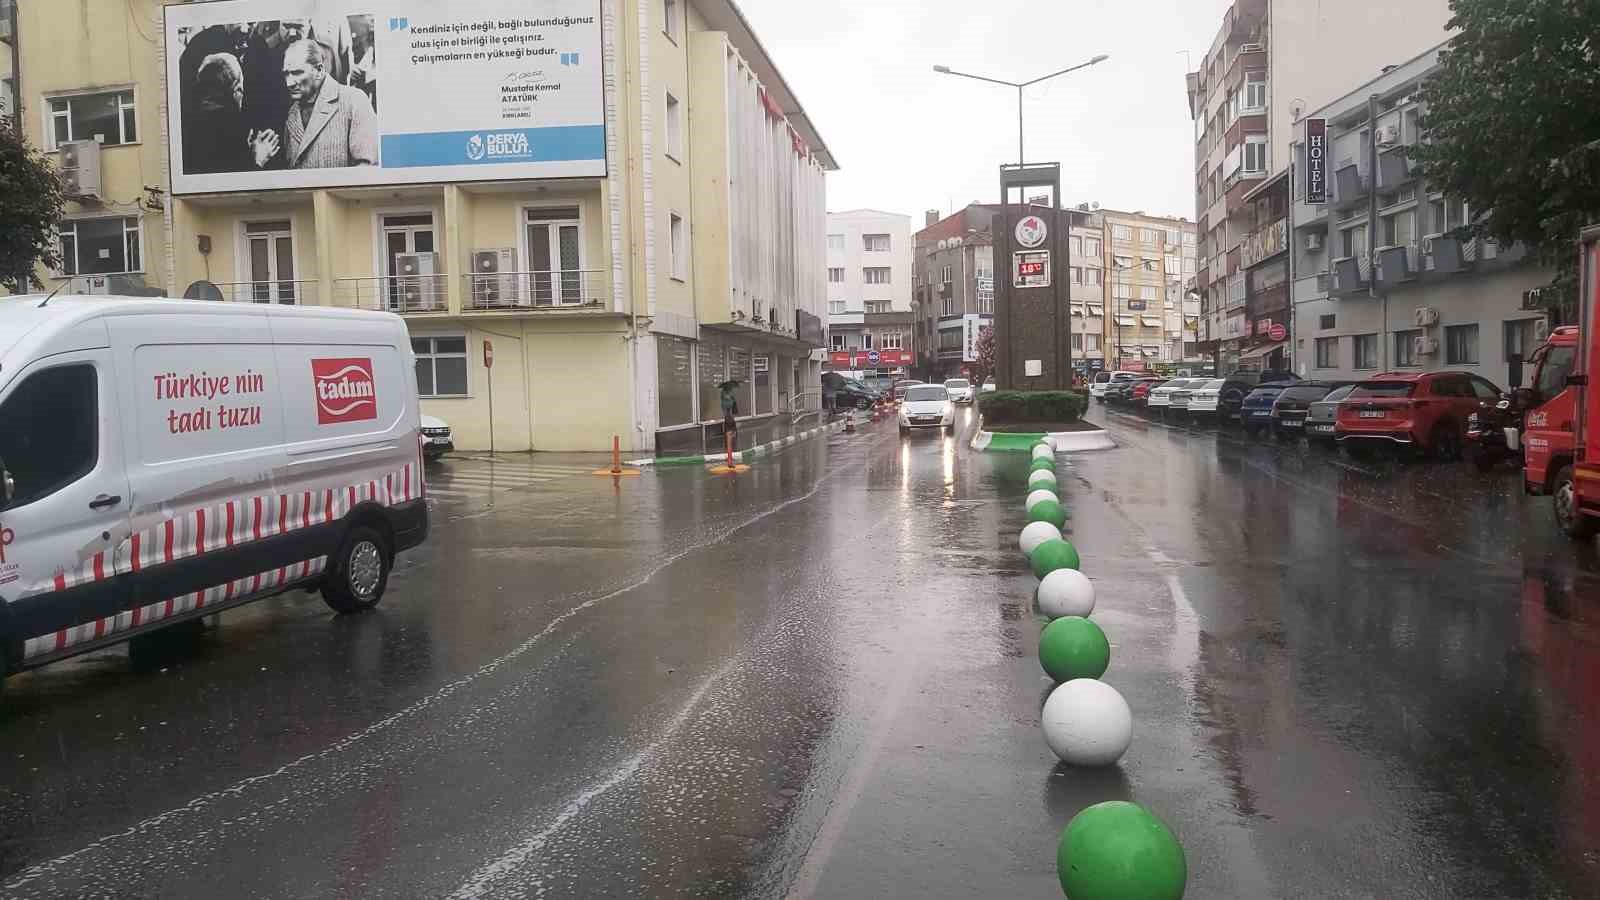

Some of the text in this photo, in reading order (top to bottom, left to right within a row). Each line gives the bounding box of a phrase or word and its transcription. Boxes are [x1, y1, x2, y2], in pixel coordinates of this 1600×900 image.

[410, 15, 595, 34] Kendiniz için değil, bağlı bulunduğunuz
[411, 33, 545, 50] ulus için el birliği ile çalışınız.
[411, 46, 558, 66] Çalışmaların en yükseği budur.
[501, 82, 561, 94] Mustafa Kemal
[501, 92, 539, 103] ATATÜRK
[486, 132, 528, 144] DERYA
[1311, 135, 1322, 193] HOTEL
[153, 368, 264, 400] Türkiye nin
[317, 375, 374, 400] tadım
[167, 404, 261, 434] tadı tuzu
